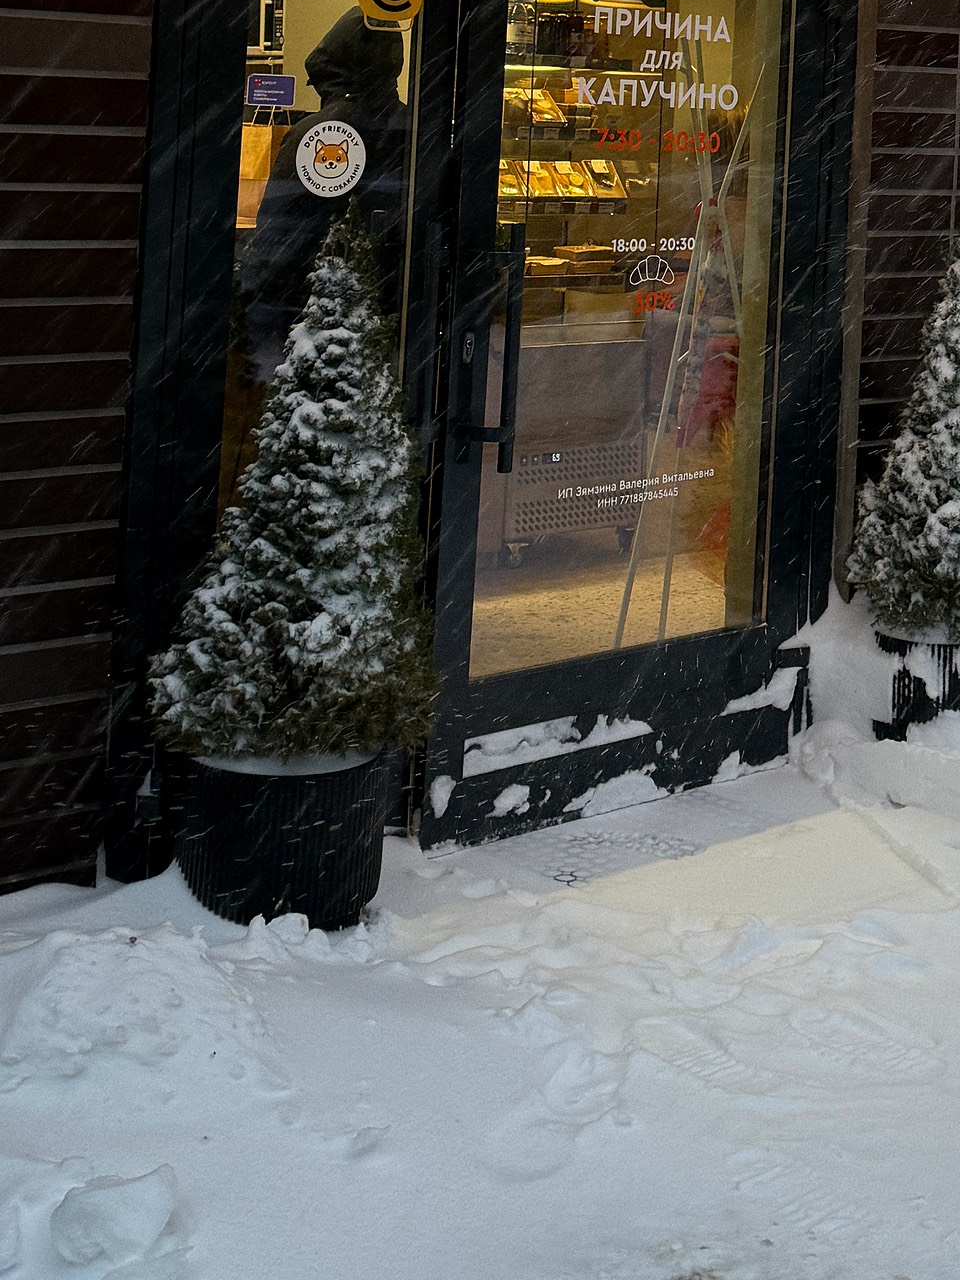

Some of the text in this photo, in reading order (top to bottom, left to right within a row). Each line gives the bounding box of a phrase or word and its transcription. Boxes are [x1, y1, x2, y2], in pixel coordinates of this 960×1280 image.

[594, 6, 731, 43] ПРИЧИНА
[577, 76, 739, 111] КАПУЧИНО
[322, 125, 360, 147] FRIENDLY
[597, 128, 642, 151] 7:30
[662, 130, 721, 153] 20:30
[611, 238, 647, 252] 18:00
[659, 237, 696, 251] 20:30
[625, 290, 676, 313] -30%
[557, 488, 573, 500] ИП
[619, 478, 660, 491] Валерия
[662, 468, 715, 483] Витальевна
[597, 487, 679, 509] ИНН 771887845445
